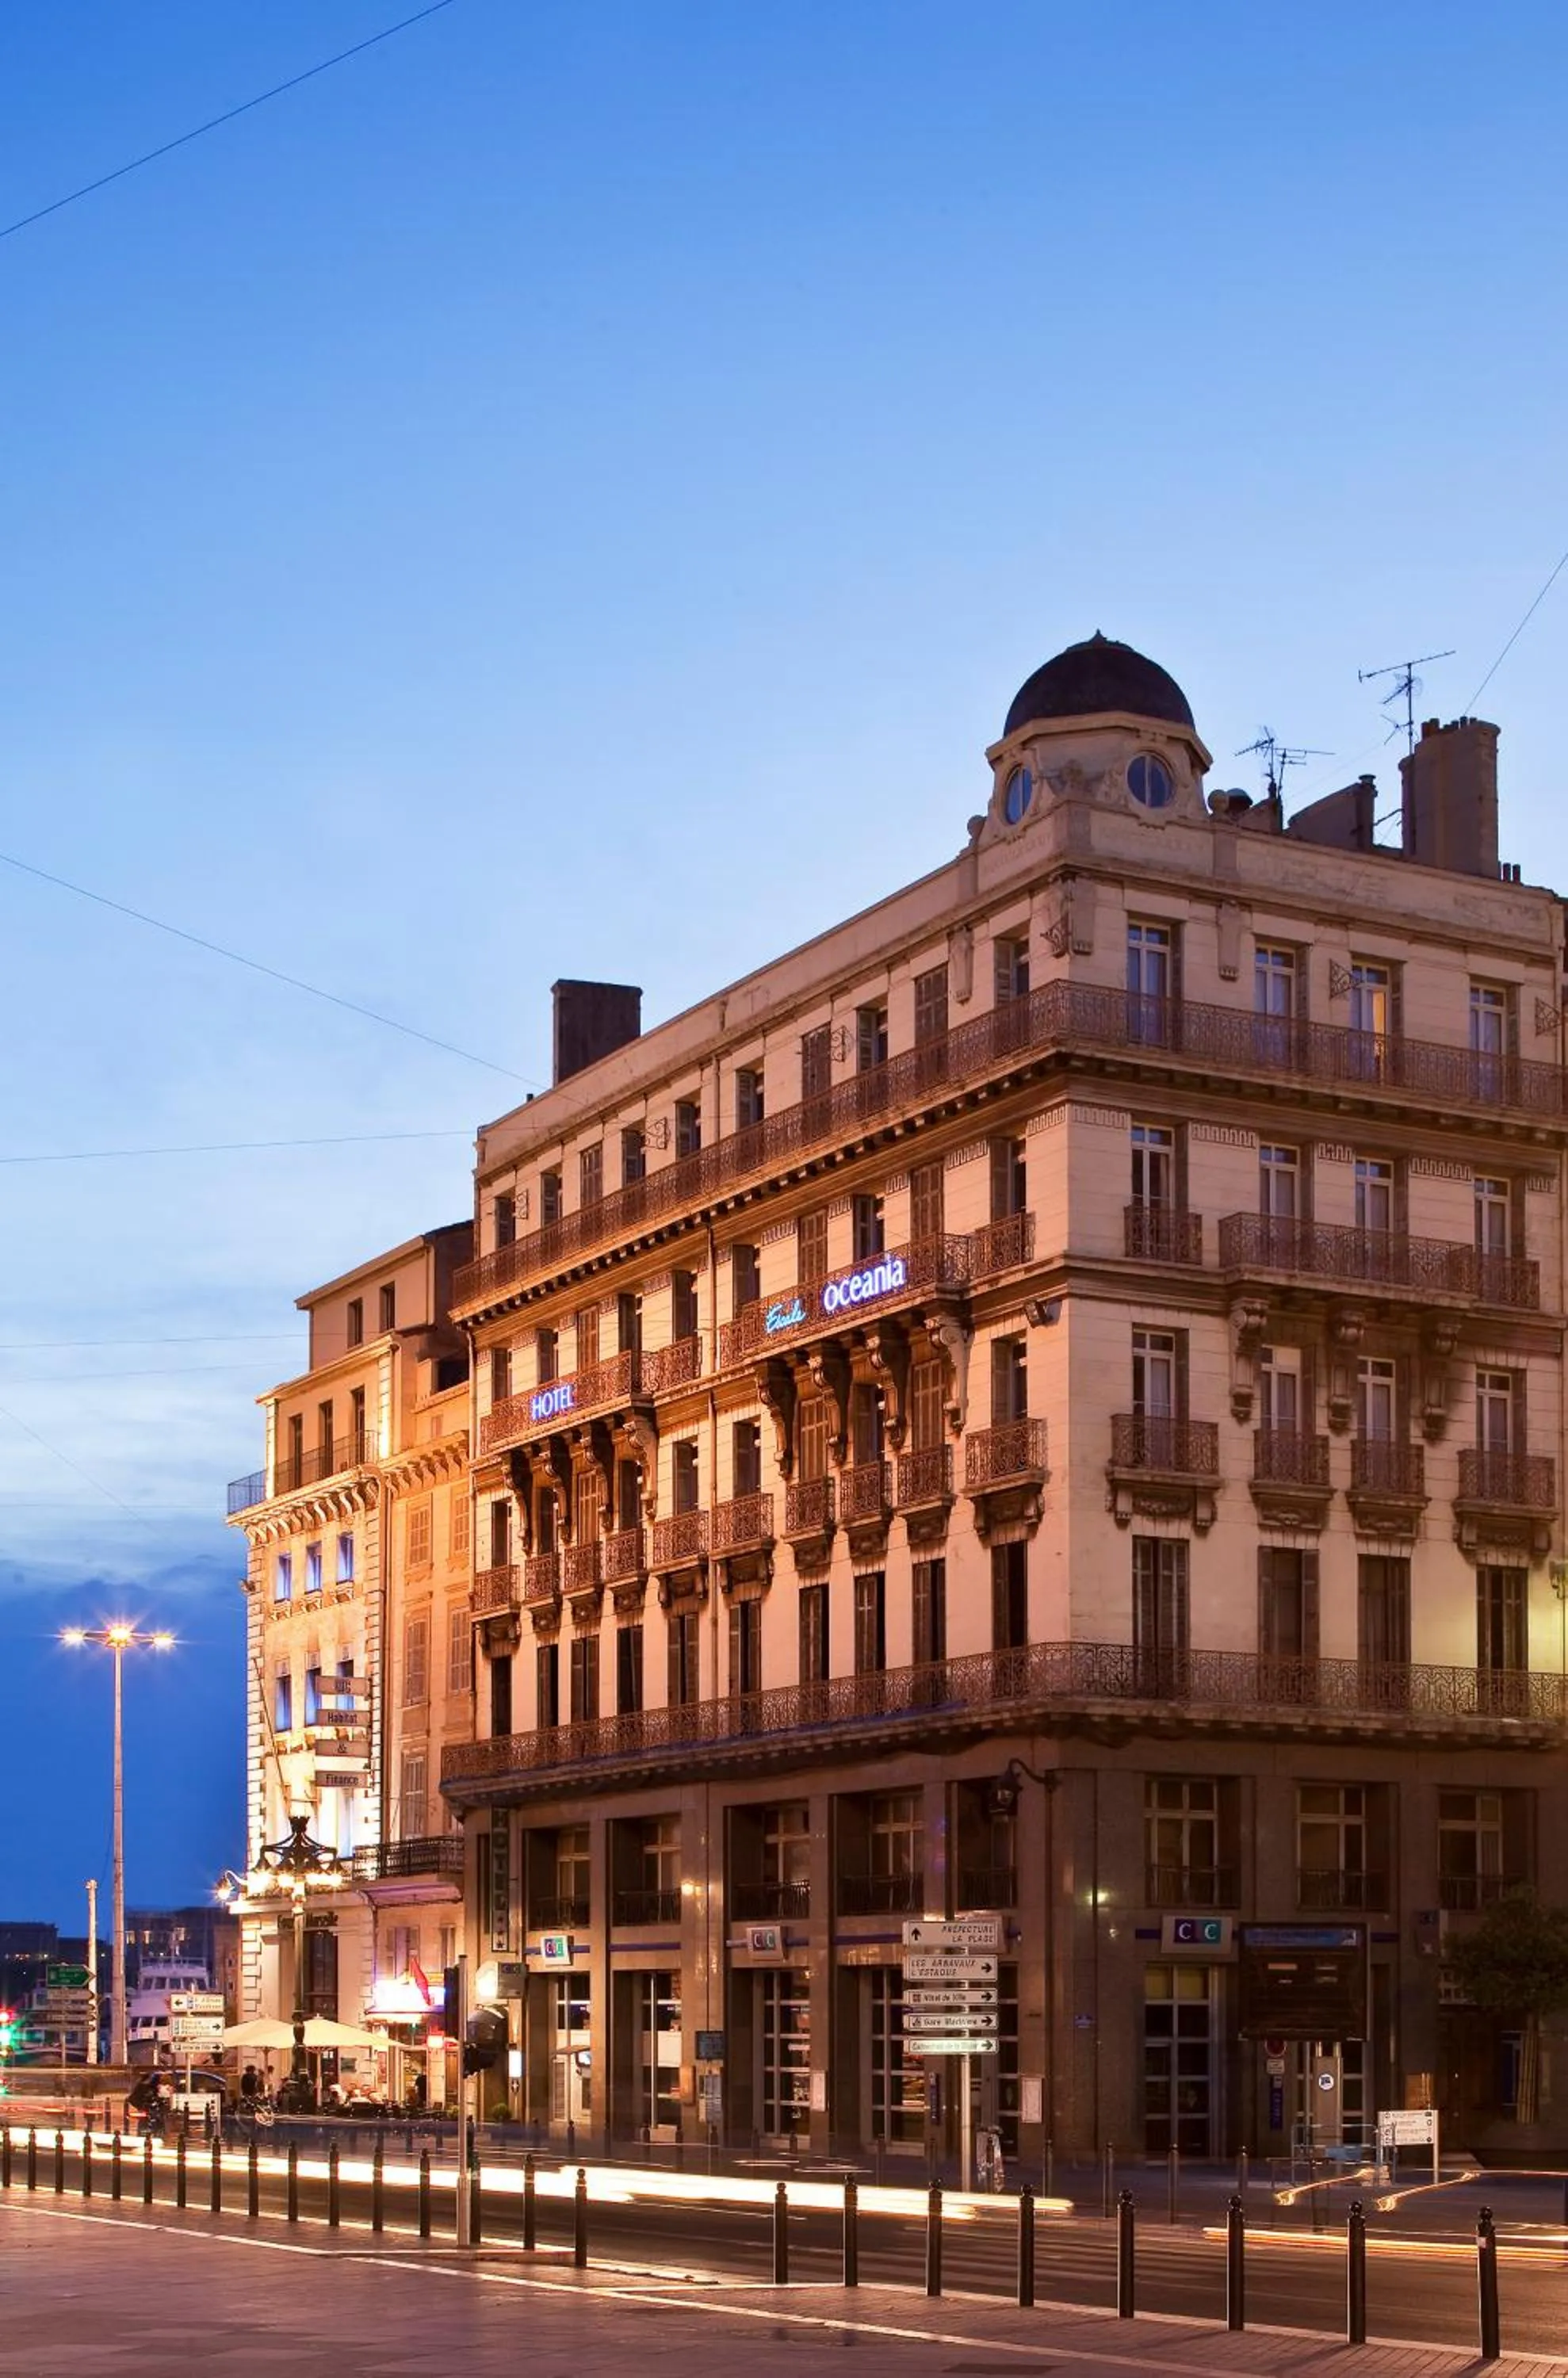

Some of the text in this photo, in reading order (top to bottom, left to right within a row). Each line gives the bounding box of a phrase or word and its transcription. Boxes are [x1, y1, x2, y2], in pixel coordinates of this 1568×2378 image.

[824, 1253, 905, 1312] oceania
[532, 1385, 574, 1421] HOTEL
[327, 1711, 358, 1724] Habitat
[337, 1745, 348, 1754] &
[325, 1773, 359, 1786] Finance
